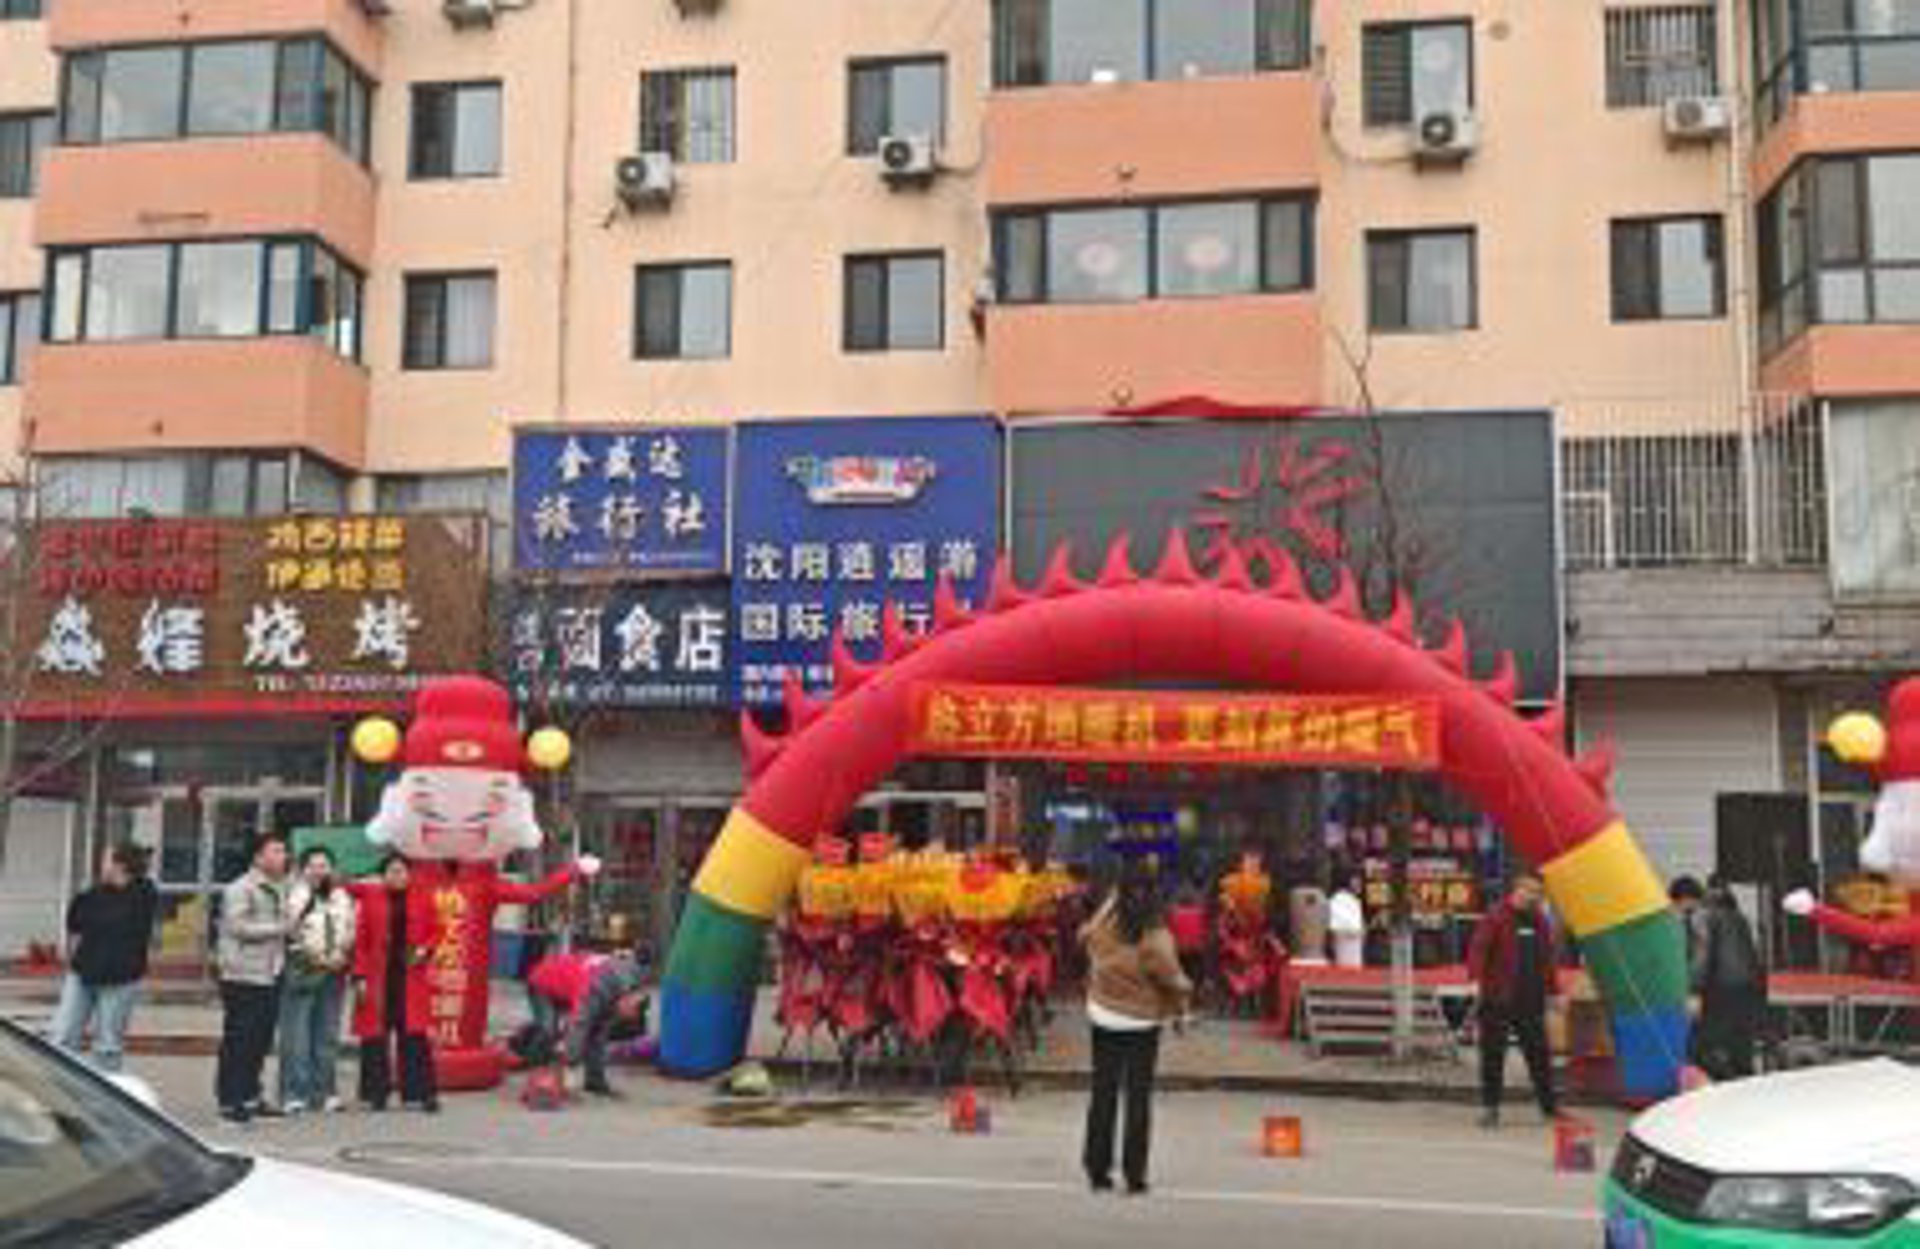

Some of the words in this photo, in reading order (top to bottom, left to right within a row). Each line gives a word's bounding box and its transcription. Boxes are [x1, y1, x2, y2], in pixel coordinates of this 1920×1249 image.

[743, 541, 977, 580] 沈阳逍遥游
[741, 598, 972, 642] 国际旅行
